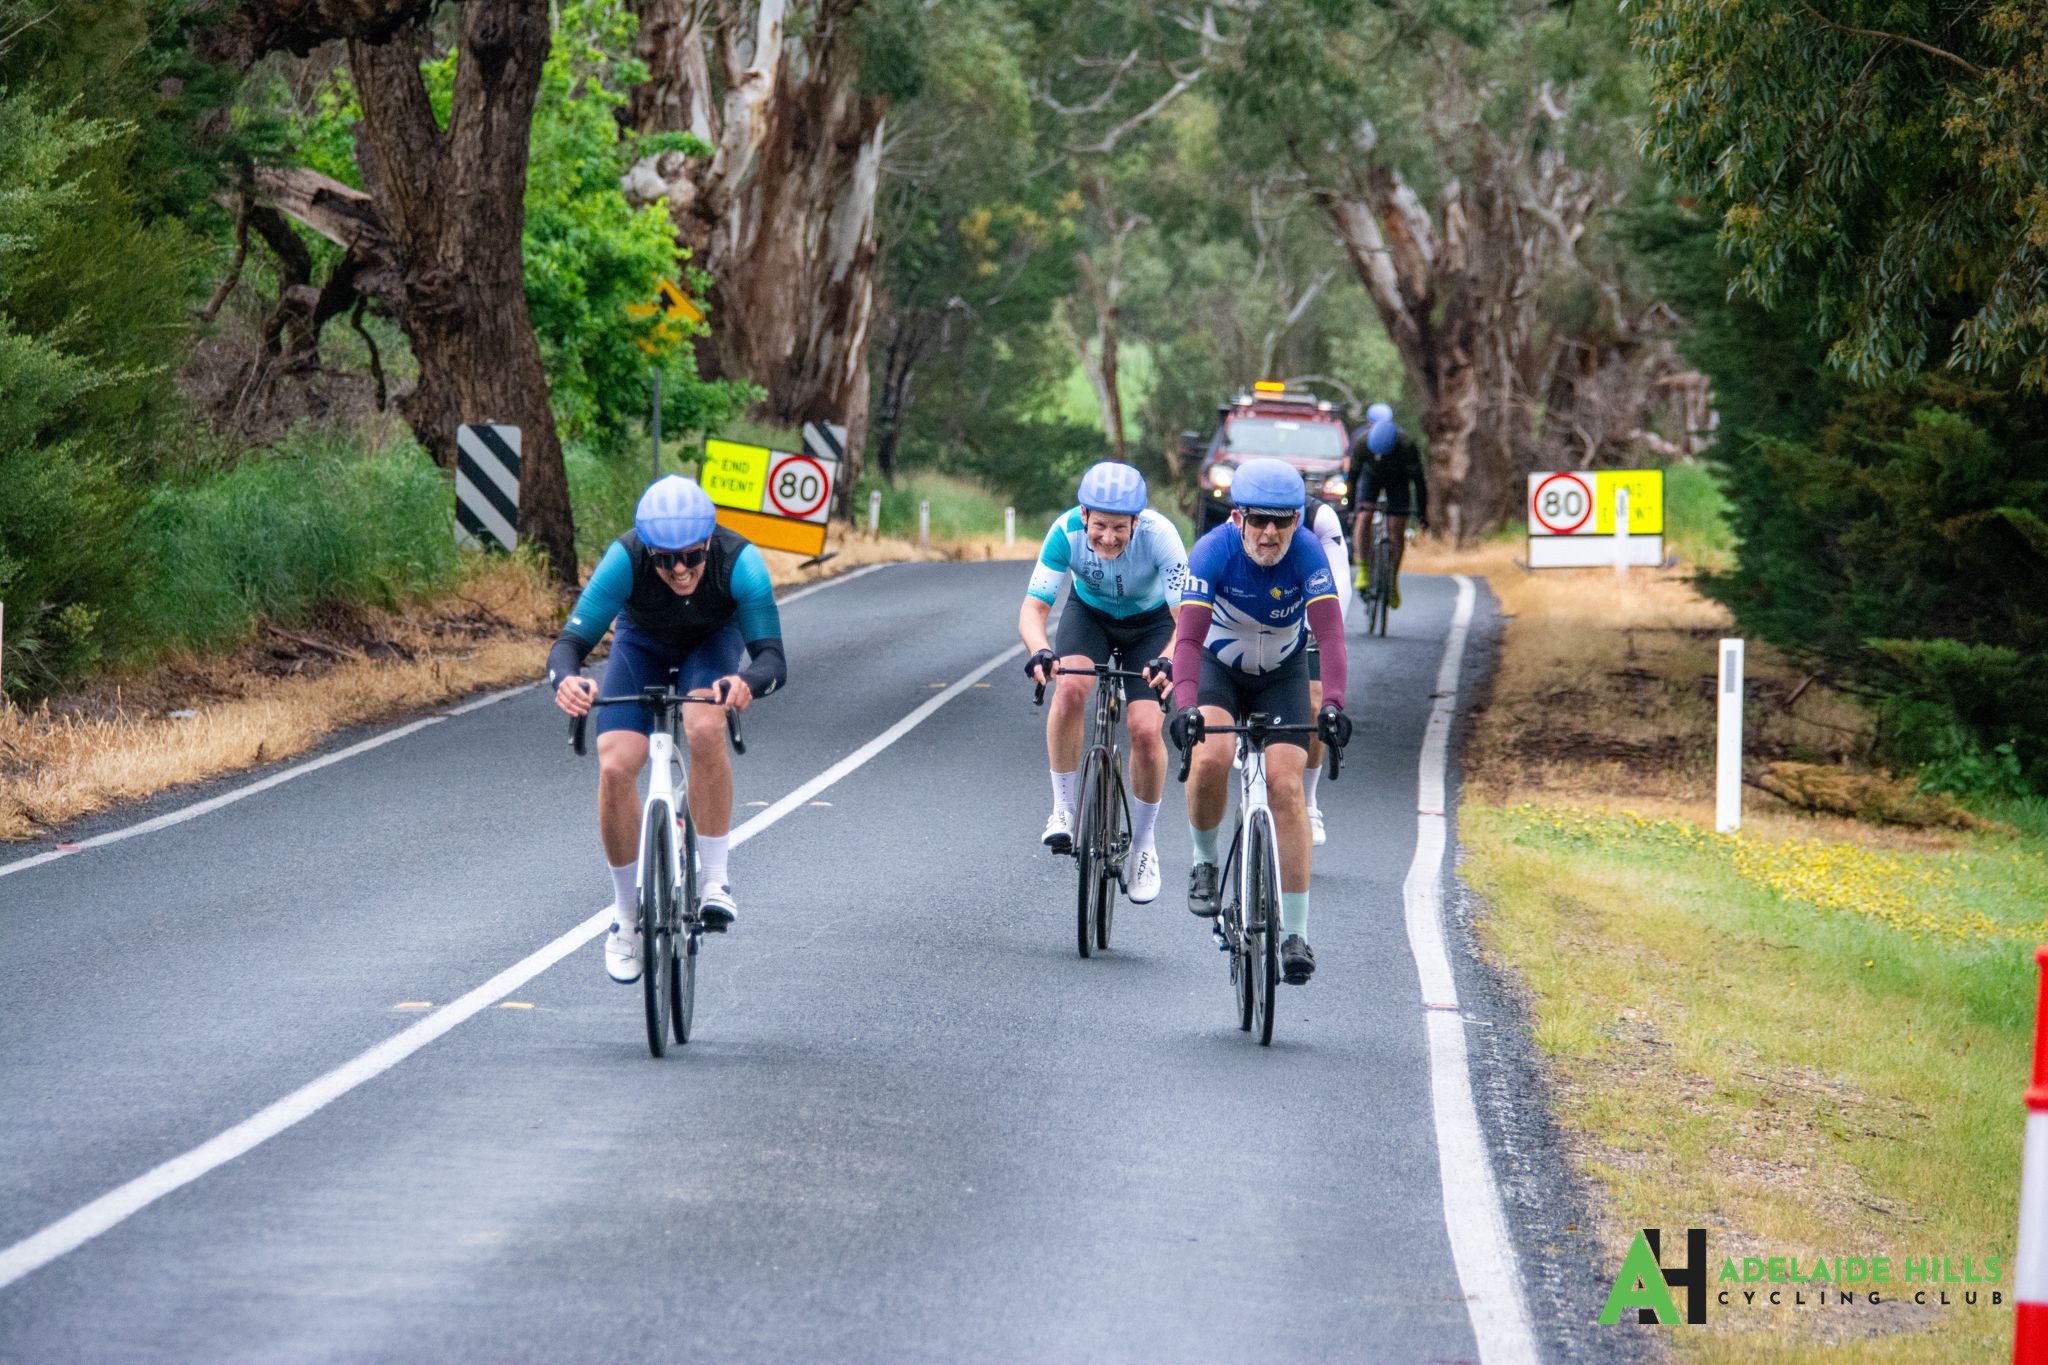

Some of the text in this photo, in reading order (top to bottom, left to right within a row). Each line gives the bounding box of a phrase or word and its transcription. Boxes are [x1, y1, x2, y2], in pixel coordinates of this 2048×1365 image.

[722, 459, 750, 474] END
[710, 475, 754, 492] EVENT
[779, 471, 818, 502] 80
[1544, 490, 1583, 517] 80
